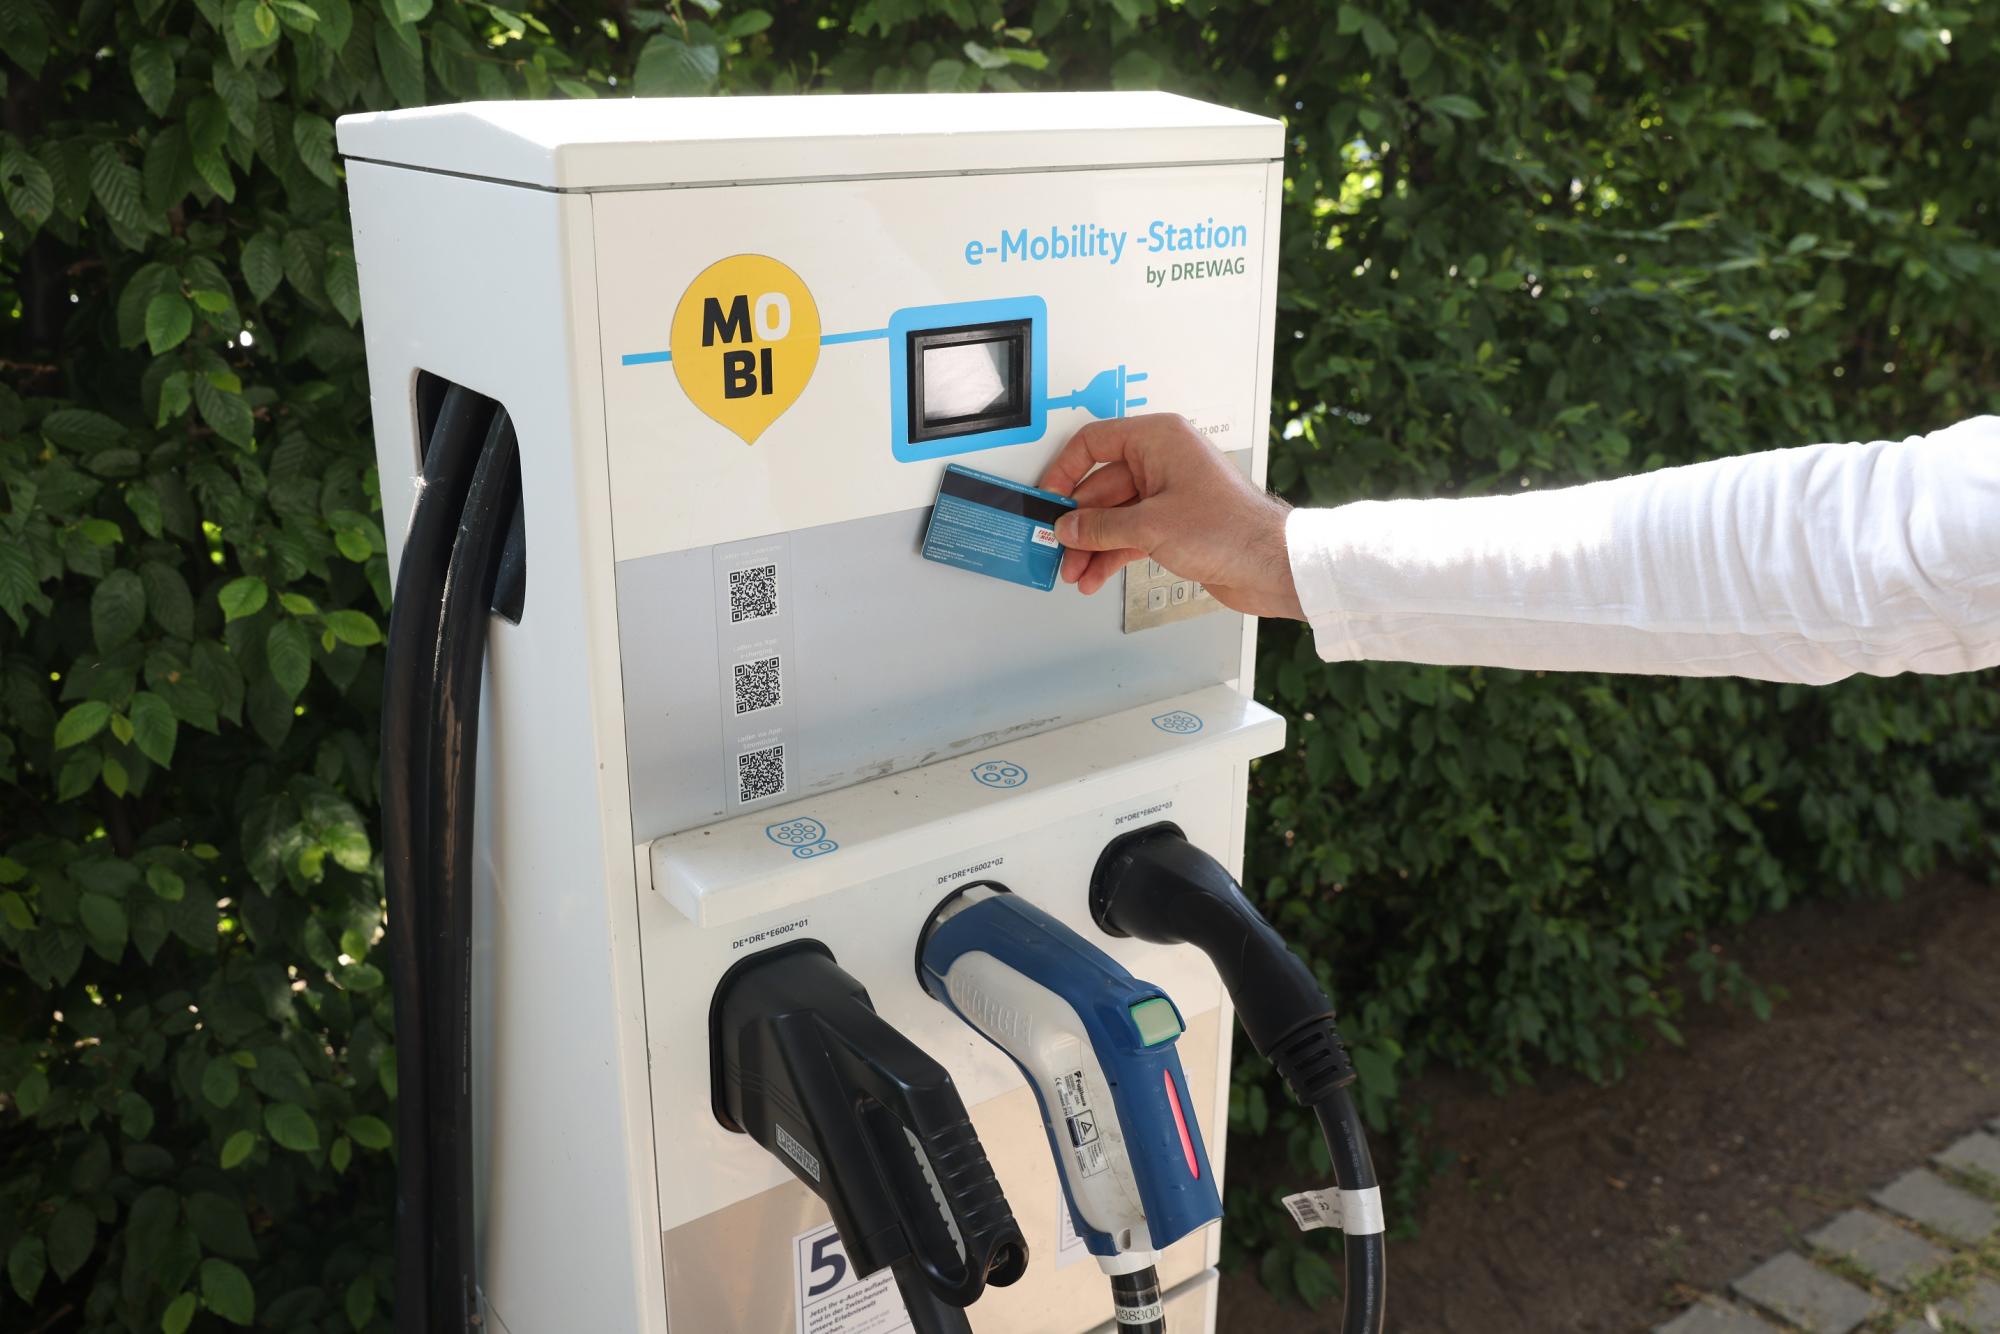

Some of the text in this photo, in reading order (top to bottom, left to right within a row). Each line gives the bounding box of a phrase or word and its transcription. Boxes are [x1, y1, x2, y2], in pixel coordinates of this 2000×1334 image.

[965, 224, 1127, 265] e-Mobility
[1146, 257, 1245, 288] by DREWAG
[702, 292, 791, 347] MO
[723, 348, 773, 399] BI
[1209, 425, 1219, 434] 00
[1220, 424, 1230, 432] 20
[1177, 586, 1184, 600] 0
[809, 1316, 823, 1326] und
[832, 1307, 844, 1316] der
[845, 1286, 888, 1310] Zwischenzeit
[810, 1305, 827, 1318] Jetzt
[840, 1290, 863, 1304] e-Auto
[810, 1320, 833, 1334] unsere
